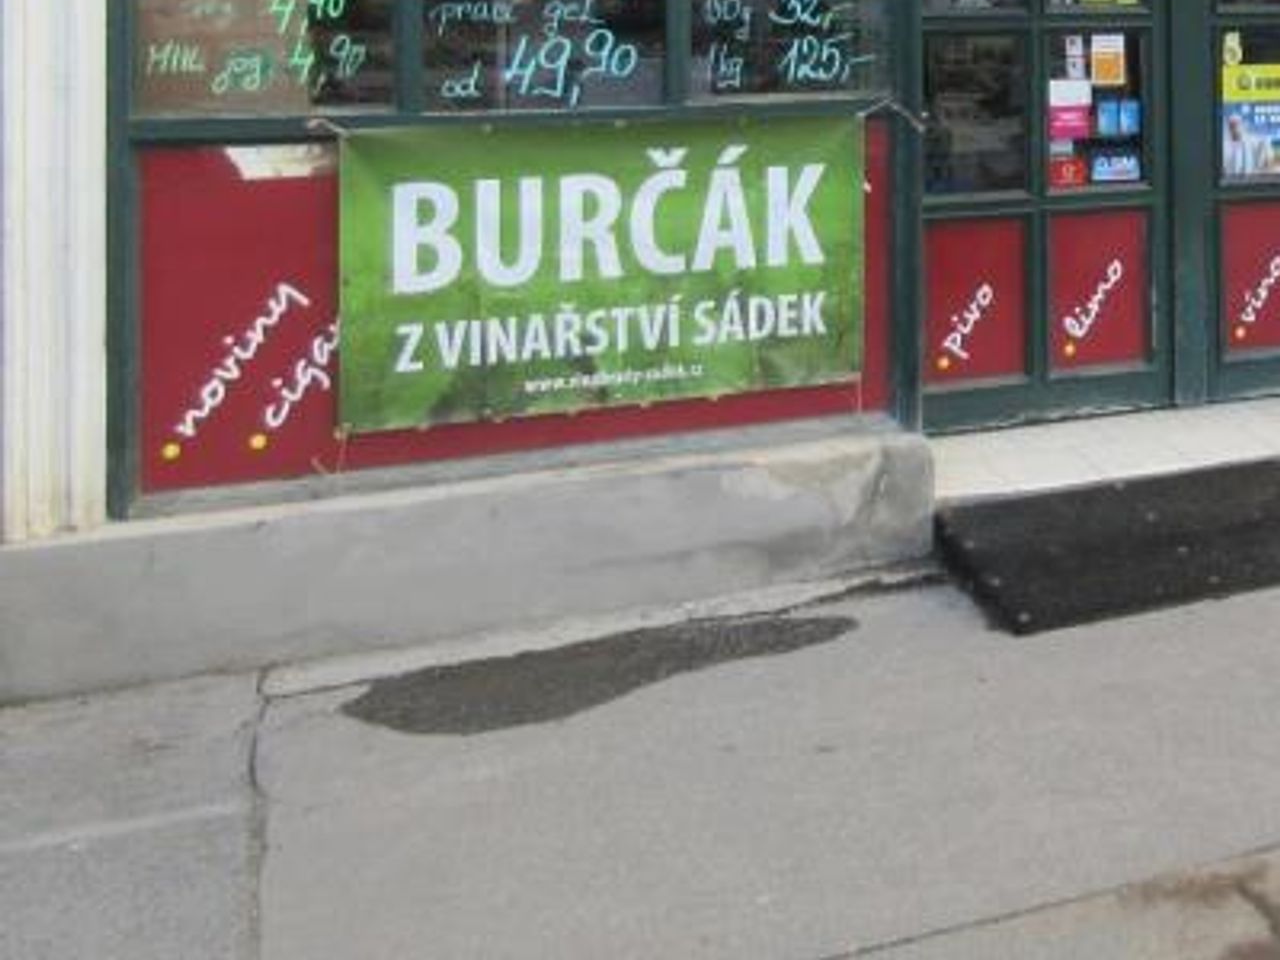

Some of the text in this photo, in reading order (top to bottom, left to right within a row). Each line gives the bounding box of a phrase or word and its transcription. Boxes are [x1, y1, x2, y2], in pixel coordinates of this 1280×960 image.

[505, 28, 638, 107] 49,90
[390, 144, 827, 296] BURČÁK
[395, 290, 828, 373] Z VINAŘSTVÍ SÁDEK
[942, 281, 994, 359] pivo
[1062, 257, 1123, 339] limo
[174, 283, 311, 437] noviny
